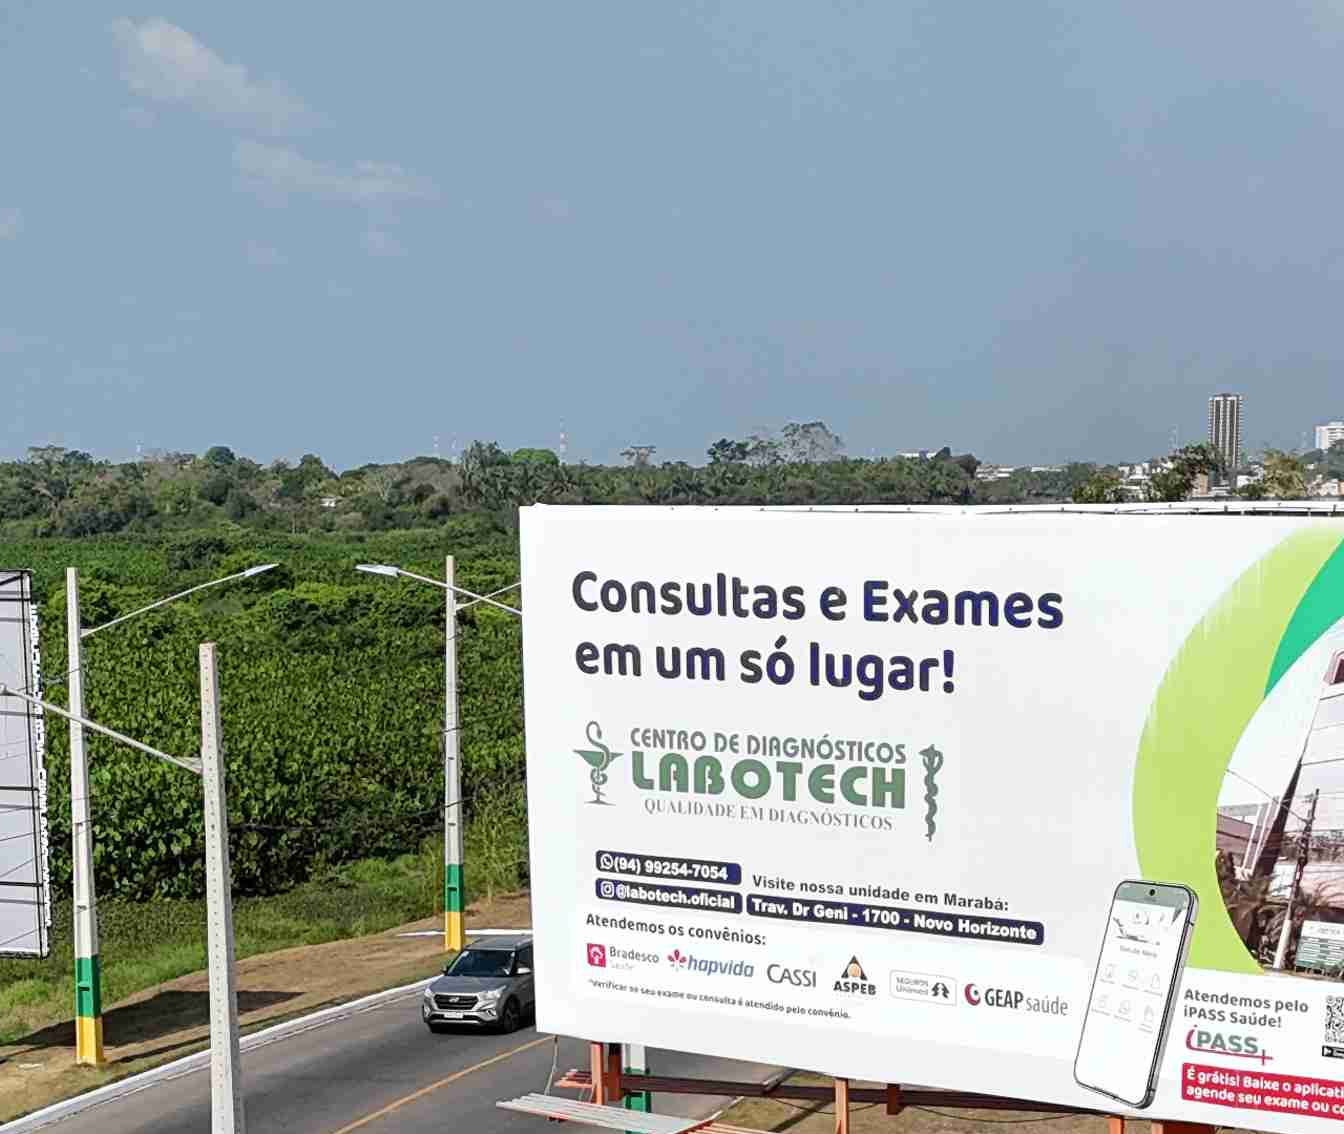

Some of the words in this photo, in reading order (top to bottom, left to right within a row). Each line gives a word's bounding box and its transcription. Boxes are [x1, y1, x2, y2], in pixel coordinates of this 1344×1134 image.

[572, 571, 806, 621] Consultas
[819, 586, 847, 621] e
[863, 580, 1064, 629] Exames
[575, 641, 641, 677] em
[656, 646, 725, 681] um
[740, 635, 795, 685] só
[809, 641, 954, 701] lugar!
[630, 727, 707, 751] CENTRO
[714, 732, 739, 754] DE
[747, 734, 906, 764] DIAGNÓSTICOS
[632, 750, 906, 810] LABOTECH
[644, 798, 736, 818] QUALIDADE
[740, 806, 763, 821] EM
[768, 808, 892, 831] DIAGNÓSTICOS
[614, 856, 641, 874] (94)
[645, 860, 728, 881] 99254-7054
[616, 883, 735, 909] @labotech.oficial
[752, 874, 795, 891] Visite
[800, 882, 844, 895] nossa
[849, 885, 910, 901] unidade
[914, 892, 938, 904] em
[943, 892, 1009, 911] Marabá:
[586, 913, 665, 935] Atendemos
[668, 924, 685, 937] os
[688, 926, 767, 946] convênios:
[752, 898, 788, 915] Trav.
[792, 901, 810, 916] Dr
[862, 908, 900, 925] 1700
[914, 913, 953, 931] Novo
[958, 919, 1037, 940] Horizonte
[609, 946, 660, 964] Bradesco
[687, 955, 755, 977] hapvida
[767, 963, 817, 988] CASSI
[833, 981, 877, 996] ASPEB
[984, 988, 1024, 1009] GEAP
[1026, 995, 1069, 1016] saúde
[1184, 988, 1271, 1010] Atendemos
[1275, 999, 1309, 1014] pelo
[1184, 1005, 1226, 1022] iPASS
[1230, 1011, 1282, 1029] Saúde!
[1186, 1066, 1196, 1081] É
[1197, 1070, 1241, 1088] grátis!
[1243, 1076, 1280, 1091] Baixe
[1282, 1082, 1292, 1092] o
[1186, 1086, 1235, 1102] agende
[1238, 1093, 1262, 1105] seu
[1264, 1096, 1310, 1111] exame
[1312, 1102, 1330, 1113] ou
